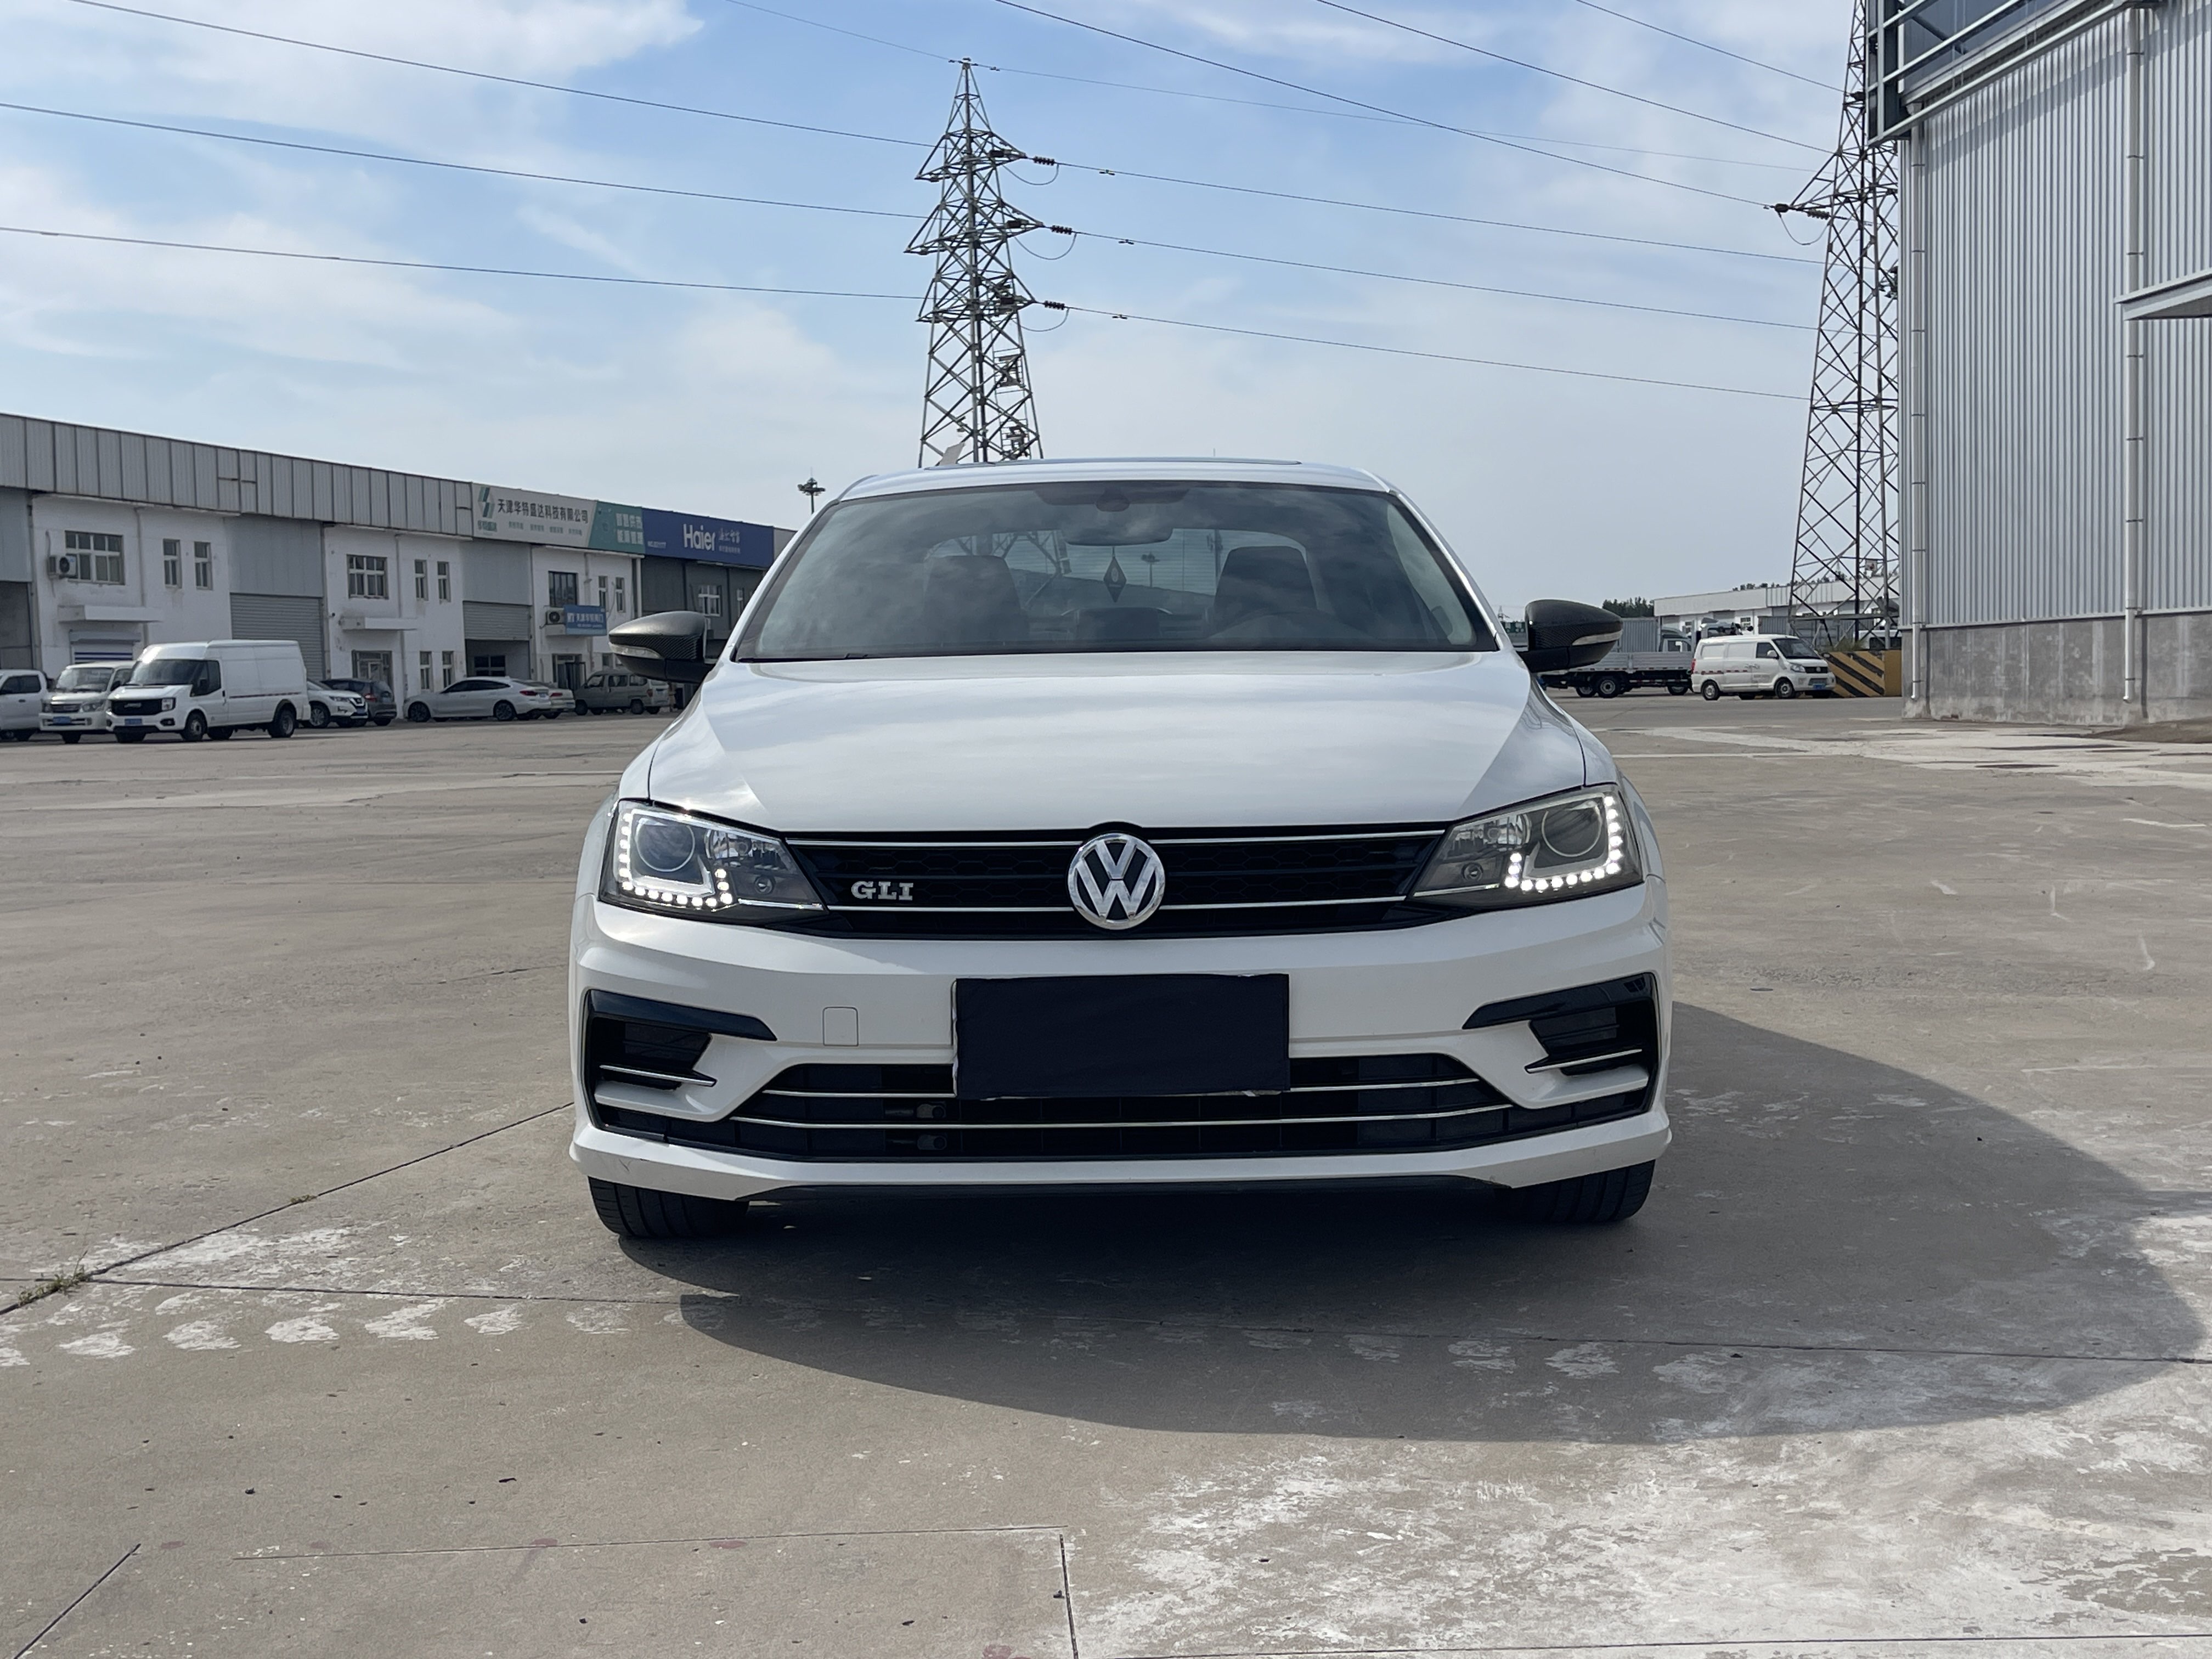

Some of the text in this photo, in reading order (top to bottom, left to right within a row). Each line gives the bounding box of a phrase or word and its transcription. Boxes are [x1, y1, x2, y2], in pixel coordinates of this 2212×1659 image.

[683, 523, 716, 551] Haier
[851, 881, 913, 900] GLI
[1074, 836, 1159, 922] VW
